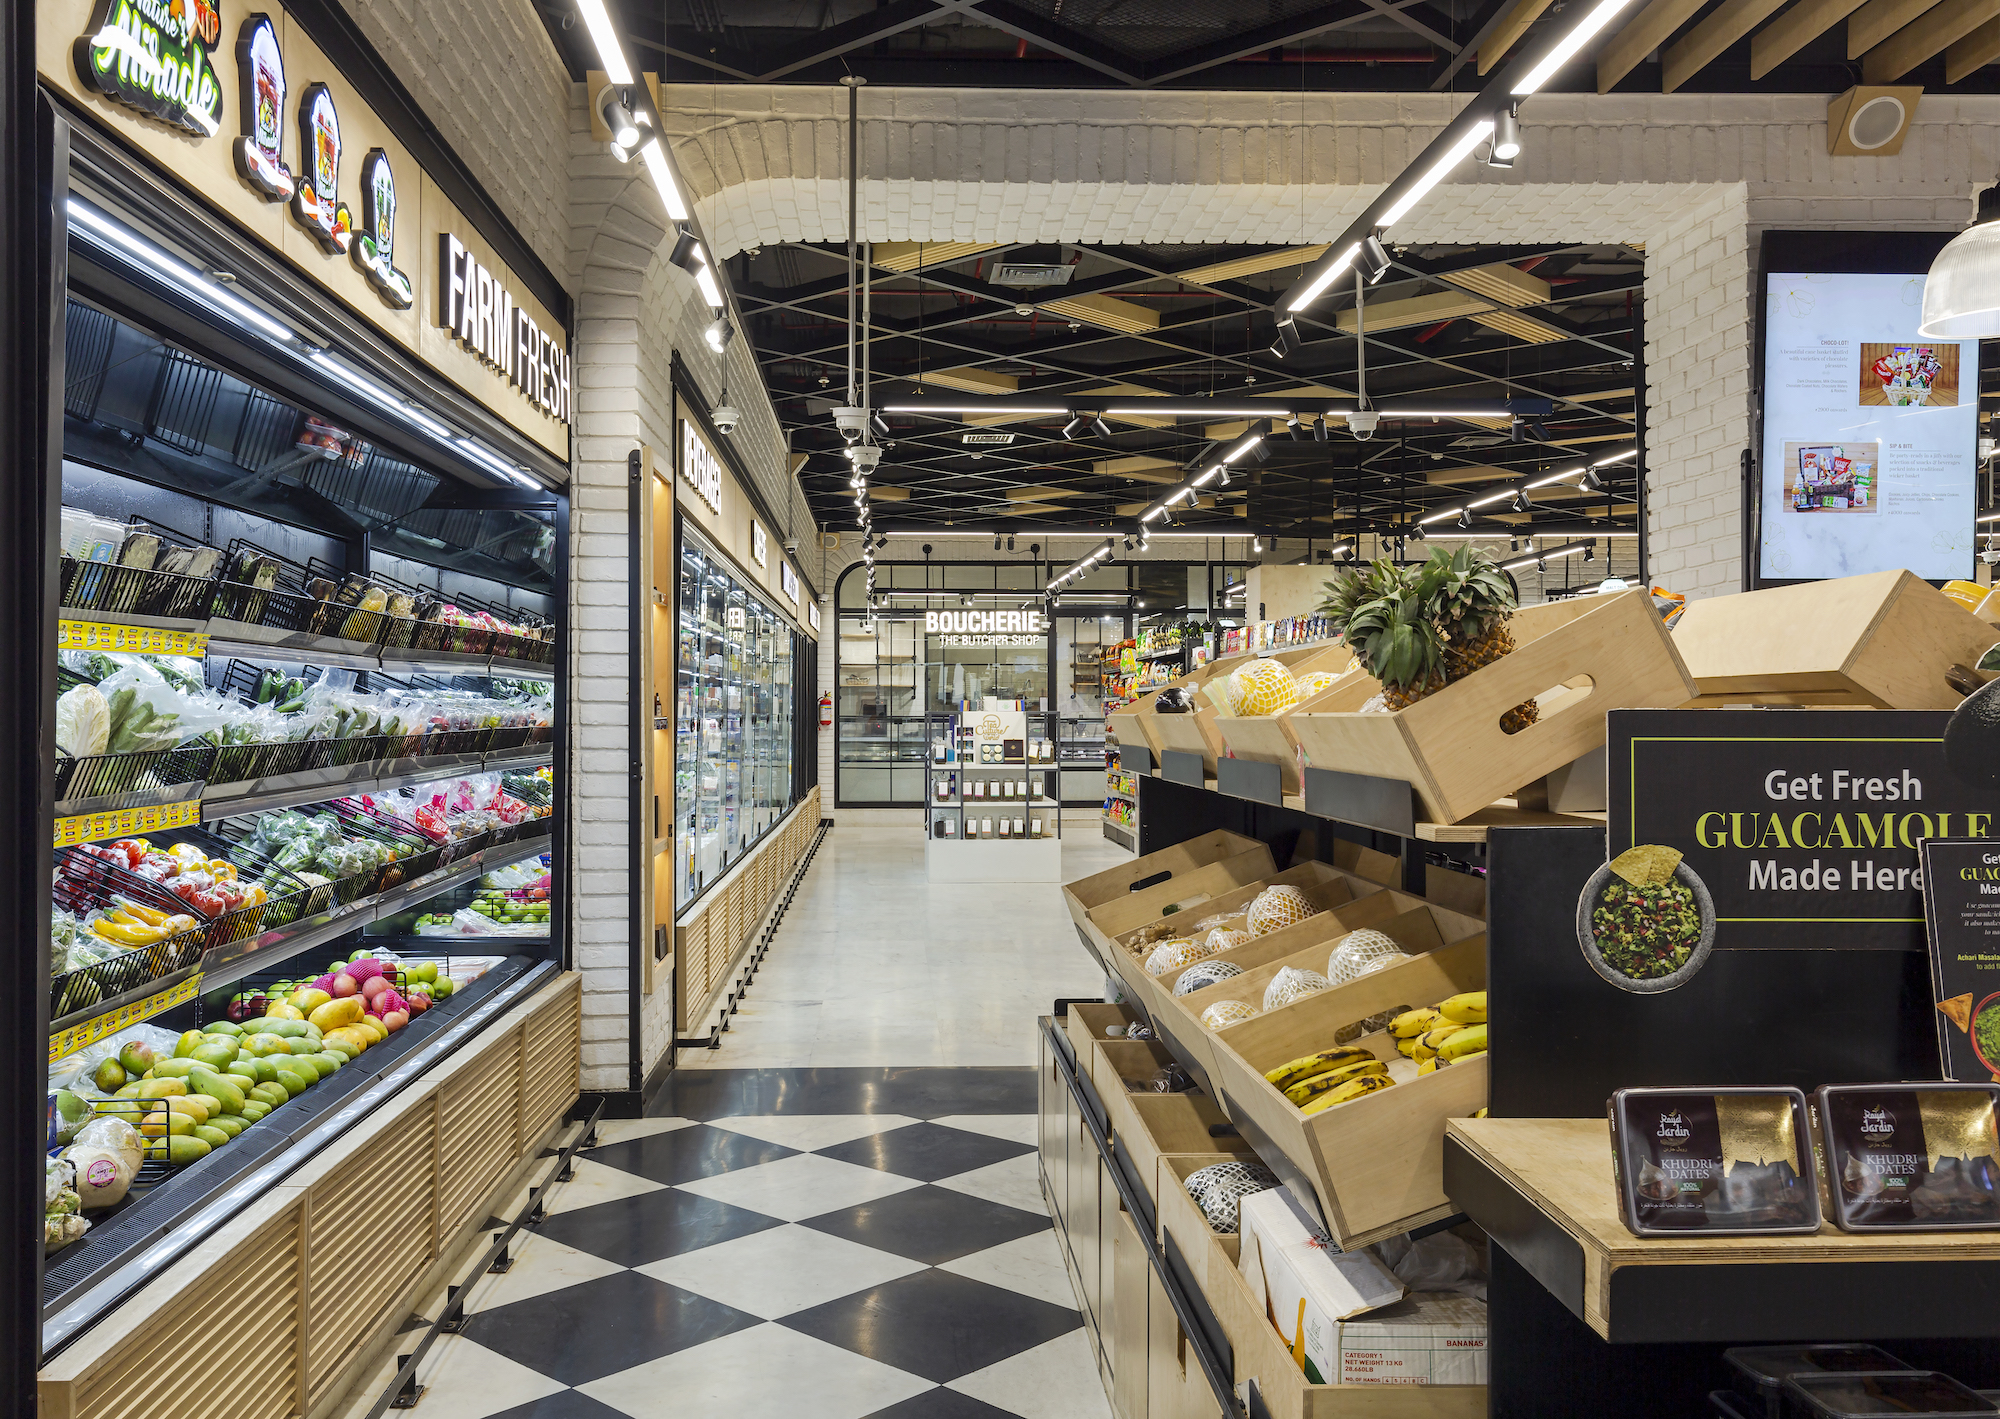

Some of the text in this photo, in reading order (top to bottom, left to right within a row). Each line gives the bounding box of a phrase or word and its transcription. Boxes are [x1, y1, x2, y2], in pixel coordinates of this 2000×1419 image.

[128, 0, 189, 48] ature's
[96, 3, 218, 115] Miracle
[448, 232, 571, 425] FARM FRESH
[684, 418, 722, 516] BEVERAGES
[926, 611, 1040, 632] BOUCHERIE
[940, 635, 1040, 646] THE BUTCHER SHOP
[1764, 768, 1922, 800] Get Fresh
[1748, 859, 1924, 891] Made Here
[1657, 1123, 1690, 1136] Jardin
[1861, 1120, 1894, 1132] Jardin
[1661, 1159, 1712, 1169] KHUDRI
[1866, 1154, 1918, 1164] KHUDRI
[1669, 1169, 1710, 1179] DATES
[1875, 1165, 1915, 1174] DATES
